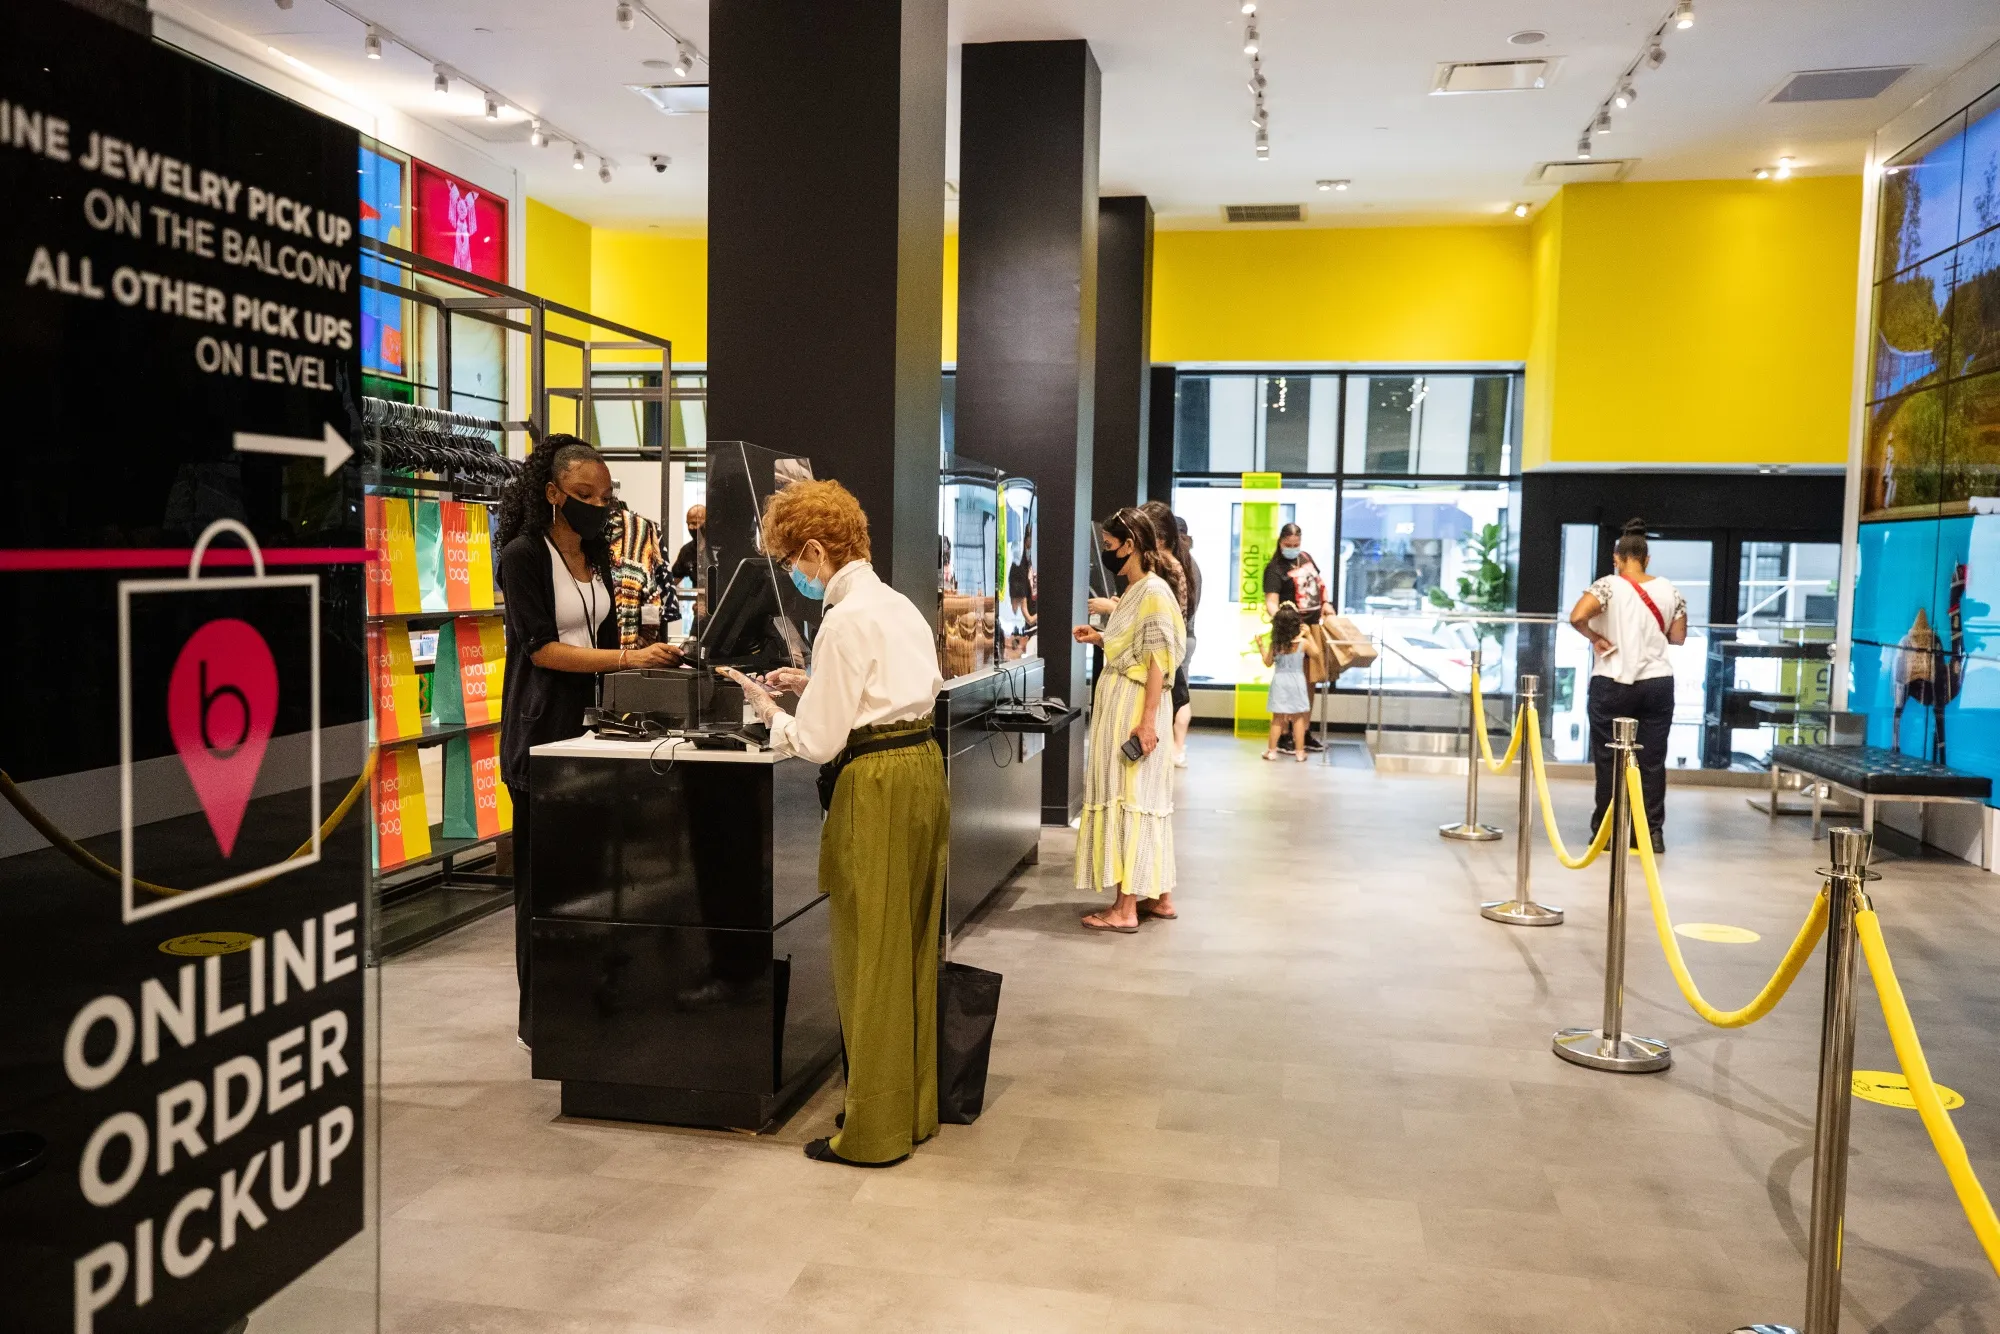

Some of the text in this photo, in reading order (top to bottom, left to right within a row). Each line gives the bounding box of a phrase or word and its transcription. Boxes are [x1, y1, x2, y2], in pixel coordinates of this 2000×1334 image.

[79, 131, 242, 214] JEWELRY
[249, 186, 314, 238] PICK
[316, 210, 352, 248] UP
[83, 188, 352, 293] ON THE BALCONY
[25, 245, 353, 350] ALL OTHER PICK UPS
[195, 336, 333, 391] ON LEVEL
[369, 563, 393, 586] bag
[448, 545, 480, 564] brown
[449, 564, 470, 585] bag
[464, 661, 497, 677] brown
[466, 679, 487, 698] bag
[199, 660, 251, 760] b
[478, 792, 497, 809] bag
[63, 902, 358, 1091] ONLINE
[78, 1009, 350, 1207] ORDER
[73, 1104, 355, 1334] PICKUP
